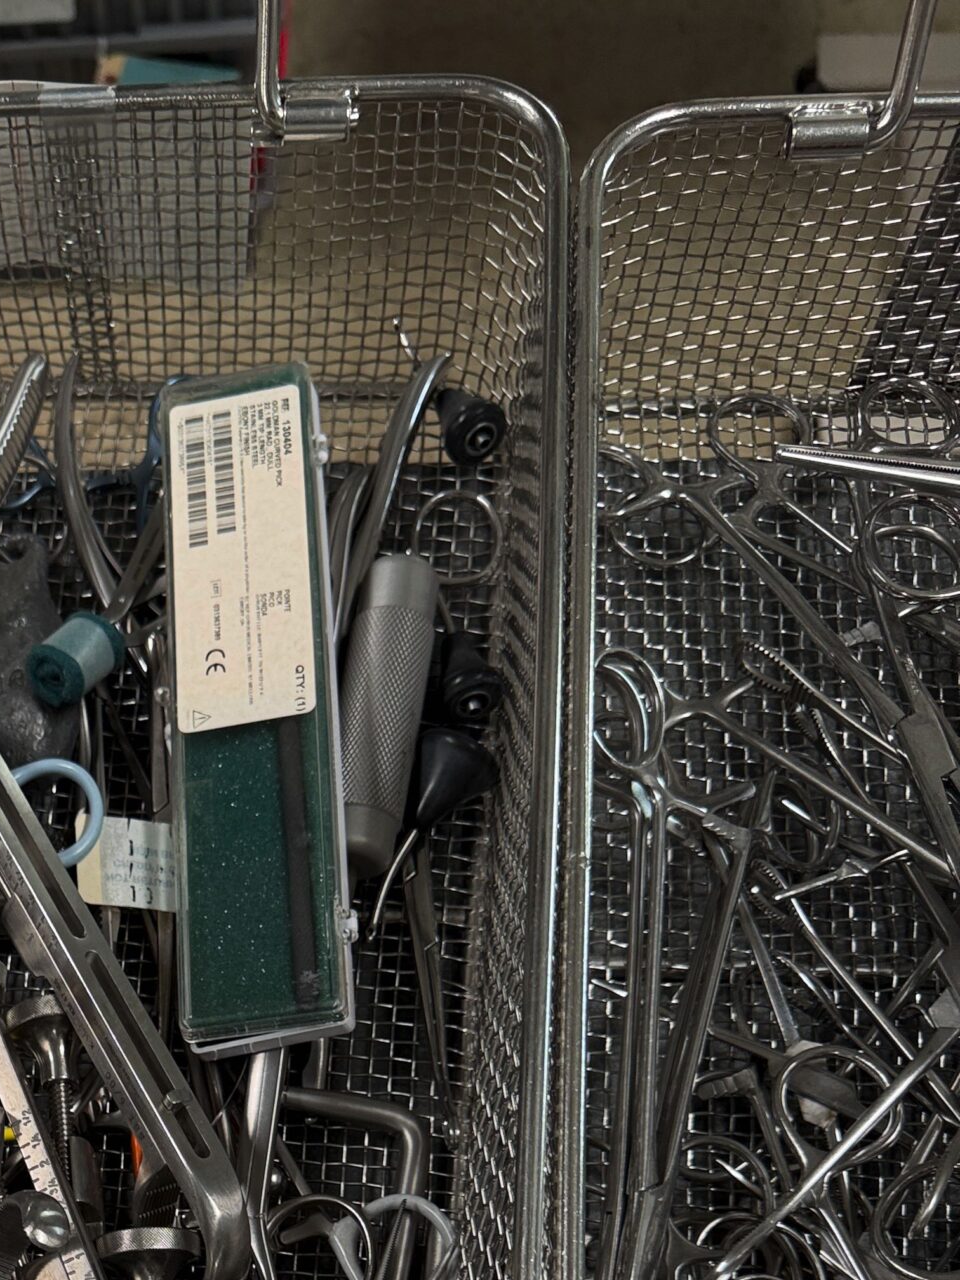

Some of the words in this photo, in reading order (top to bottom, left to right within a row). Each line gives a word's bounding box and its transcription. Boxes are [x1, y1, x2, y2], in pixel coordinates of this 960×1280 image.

[241, 405, 249, 431] EBONY
[248, 403, 257, 444] STAINLESS
[271, 399, 280, 437] GOLDMAN
[242, 431, 250, 456] FINISH
[258, 434, 266, 465] LENGTH
[281, 419, 292, 456] 130404
[250, 444, 258, 469] STEEL
[266, 451, 274, 472] DULL
[273, 437, 282, 469] CURVED
[274, 468, 283, 487] PICK
[282, 588, 291, 613] POINTE
[293, 664, 305, 692] QTY:
[293, 696, 307, 713] (1)
